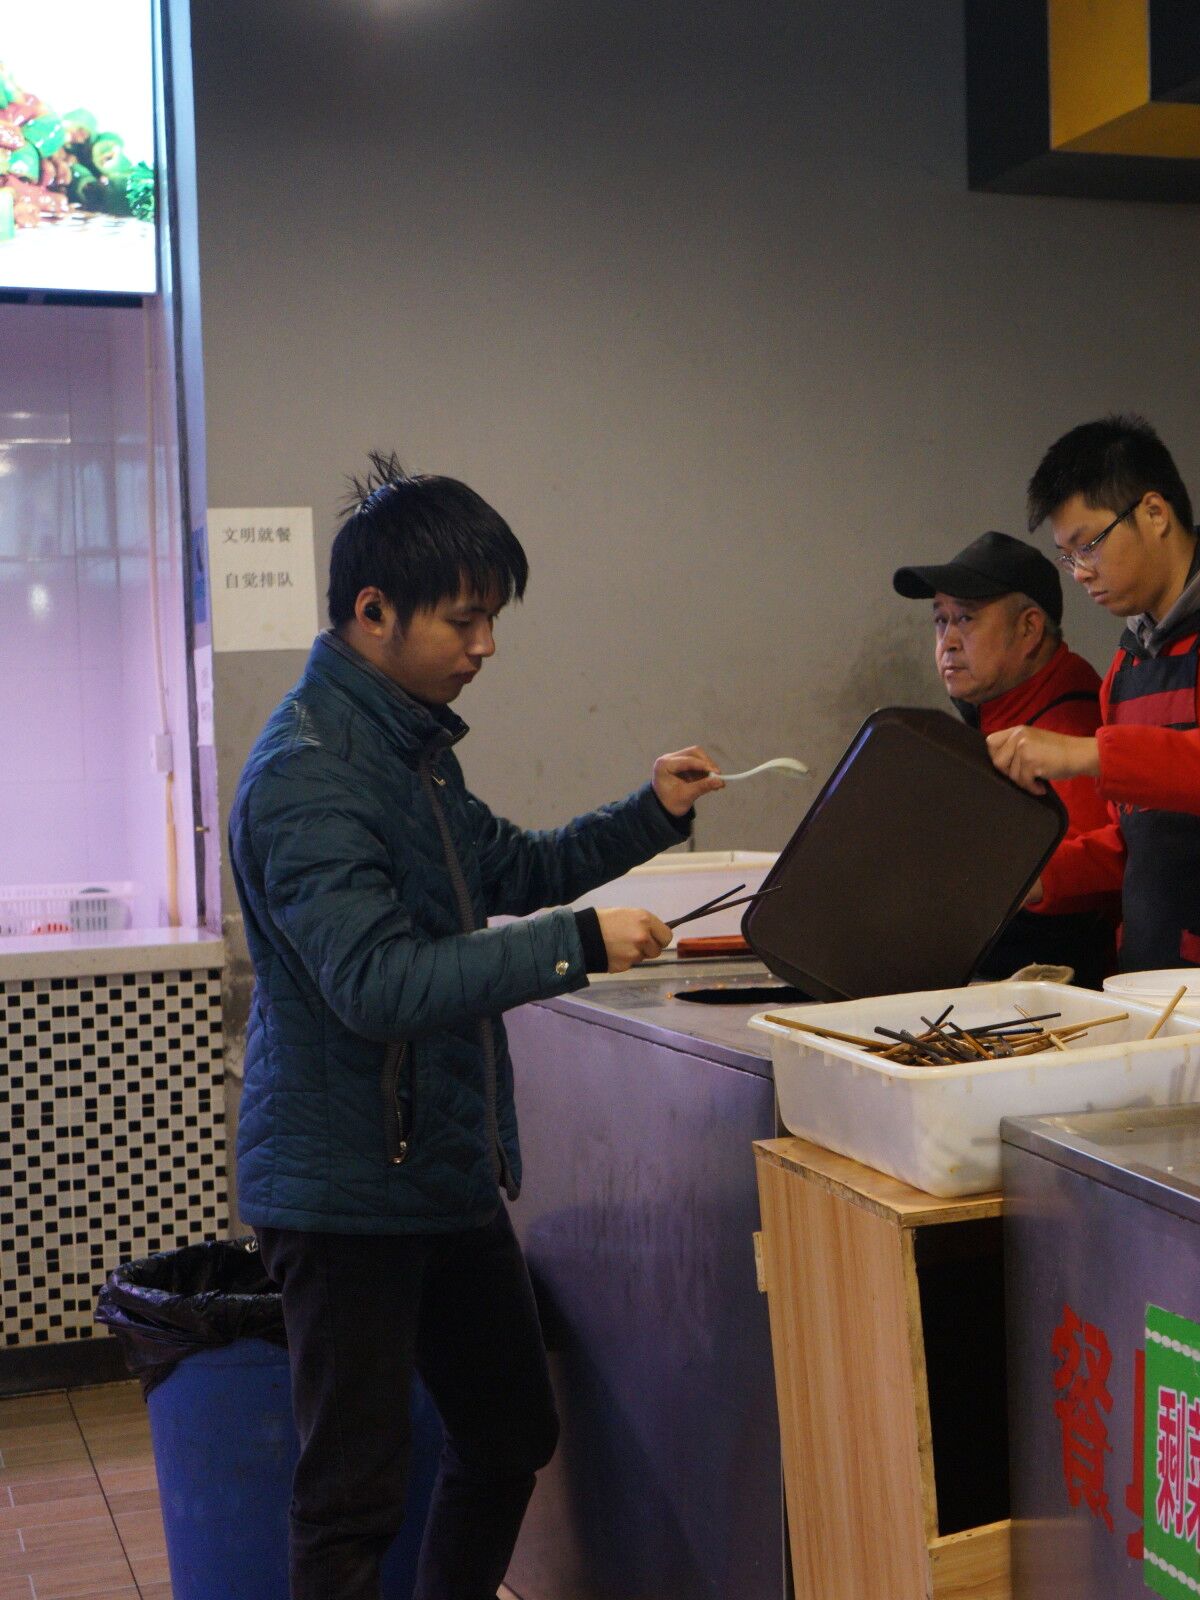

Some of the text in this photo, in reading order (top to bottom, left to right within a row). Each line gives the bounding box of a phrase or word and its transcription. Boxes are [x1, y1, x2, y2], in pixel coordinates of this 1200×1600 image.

[222, 526, 292, 544] 文明就餐
[225, 571, 294, 589] 自觉排队
